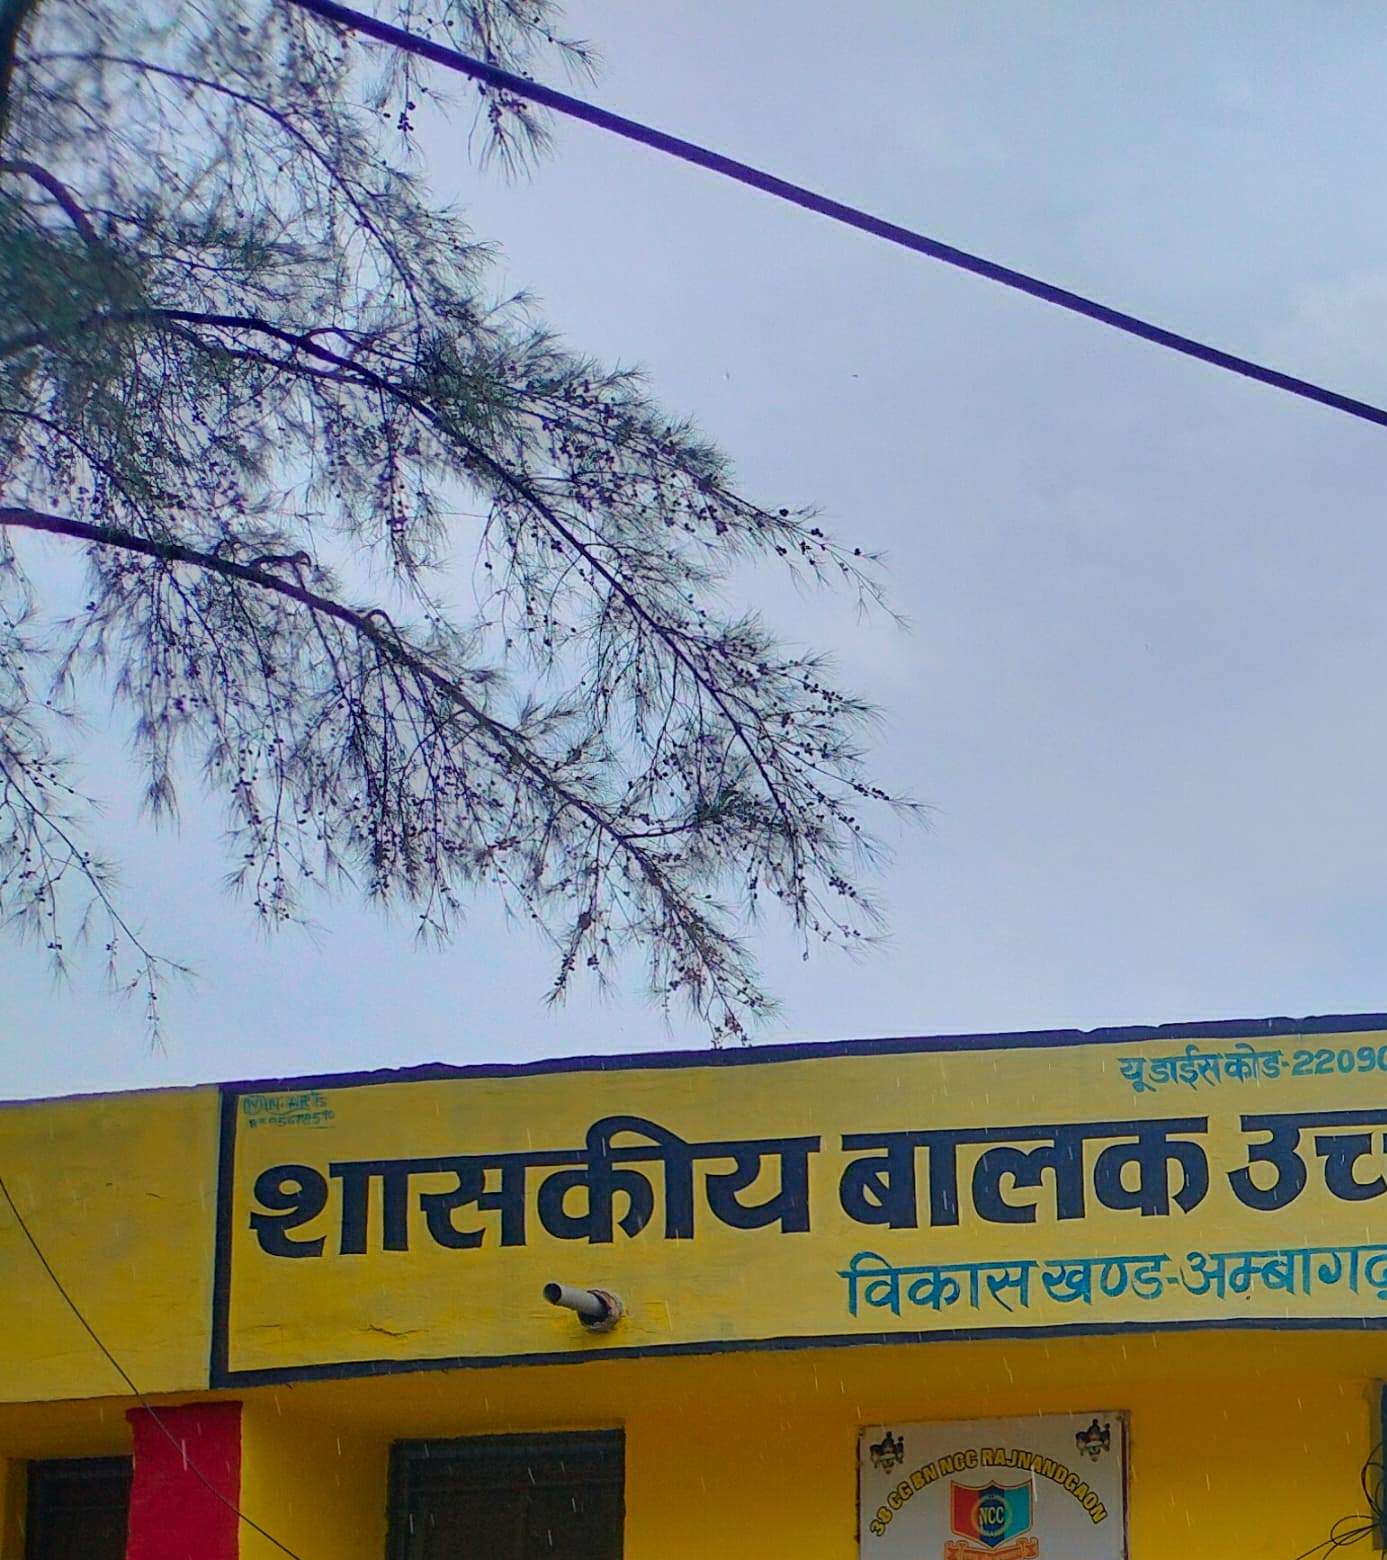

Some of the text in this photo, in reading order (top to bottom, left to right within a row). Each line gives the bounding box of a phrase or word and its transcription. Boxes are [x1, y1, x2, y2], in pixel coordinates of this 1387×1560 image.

[248, 1114, 822, 1259] शासकीय
[838, 1115, 1210, 1230] बालक
[886, 1483, 915, 1511] CG
[910, 1465, 939, 1492] BN
[940, 1449, 979, 1477] NCC
[980, 1448, 1109, 1525] RAJNANDGAON
[978, 1505, 1005, 1526] NCC
